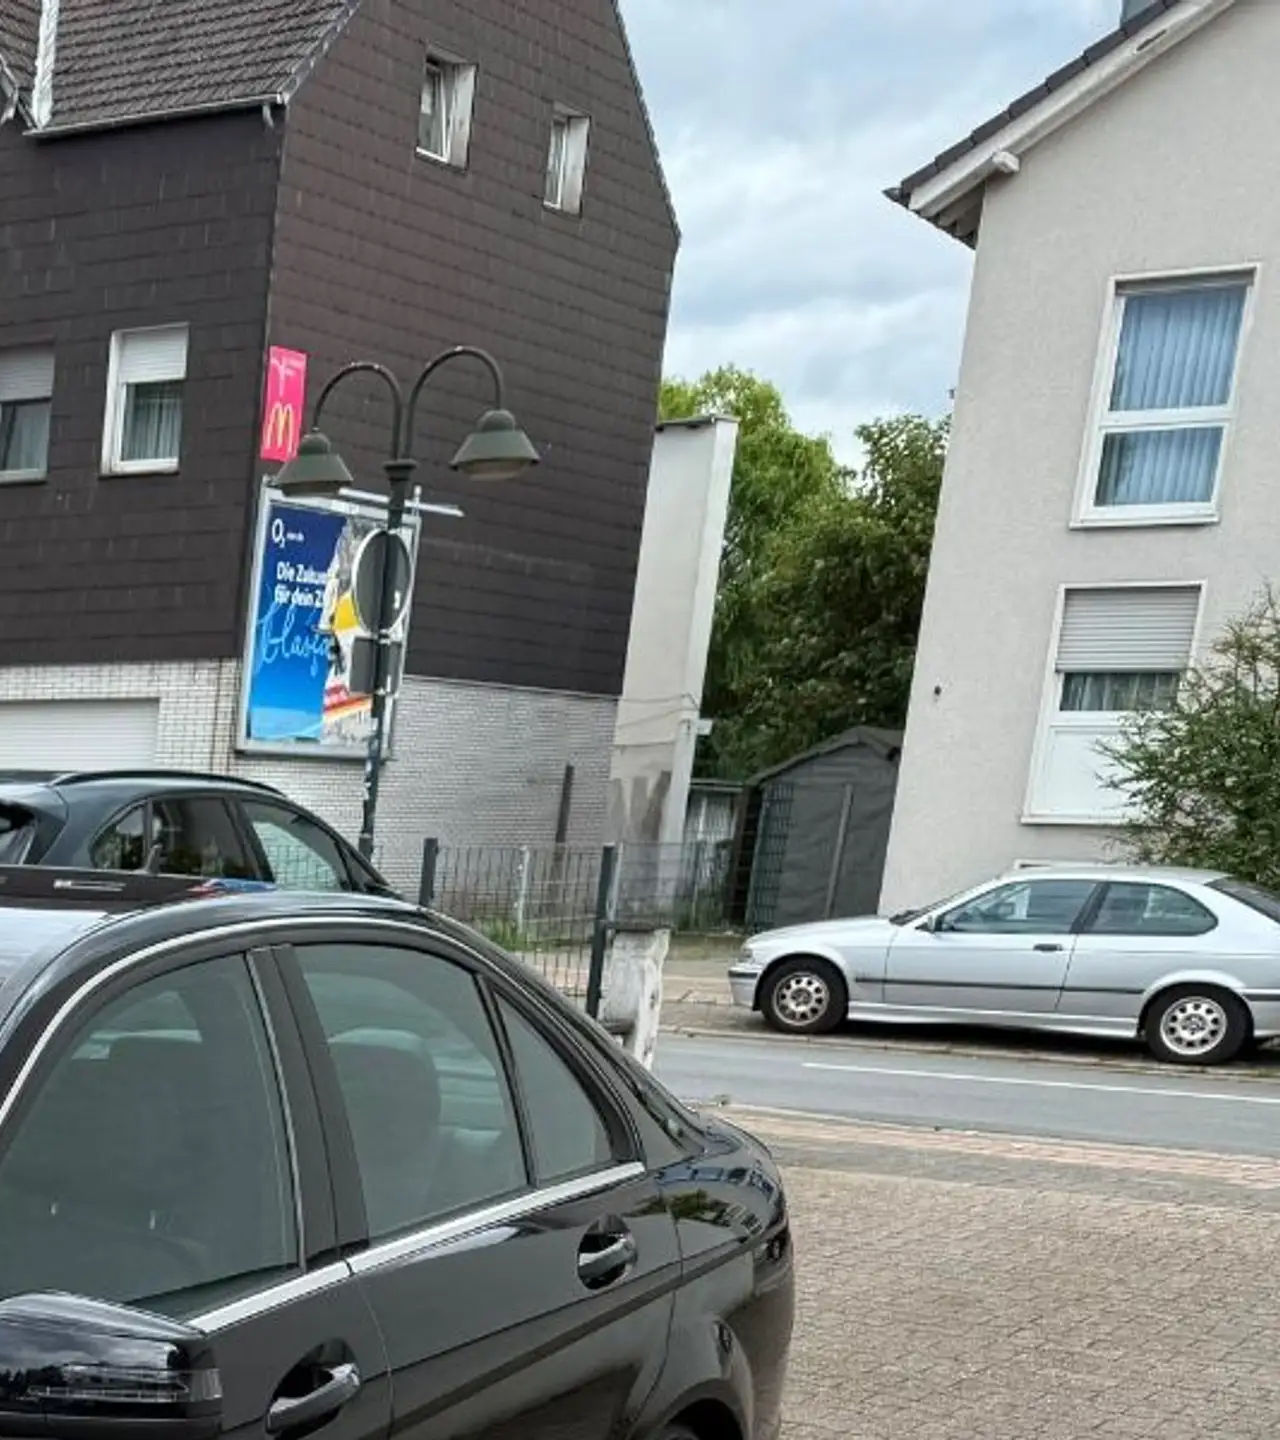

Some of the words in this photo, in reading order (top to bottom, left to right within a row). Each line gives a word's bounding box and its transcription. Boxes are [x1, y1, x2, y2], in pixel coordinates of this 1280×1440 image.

[277, 561, 295, 581] Die
[275, 583, 290, 604] für
[291, 585, 313, 605] dein
